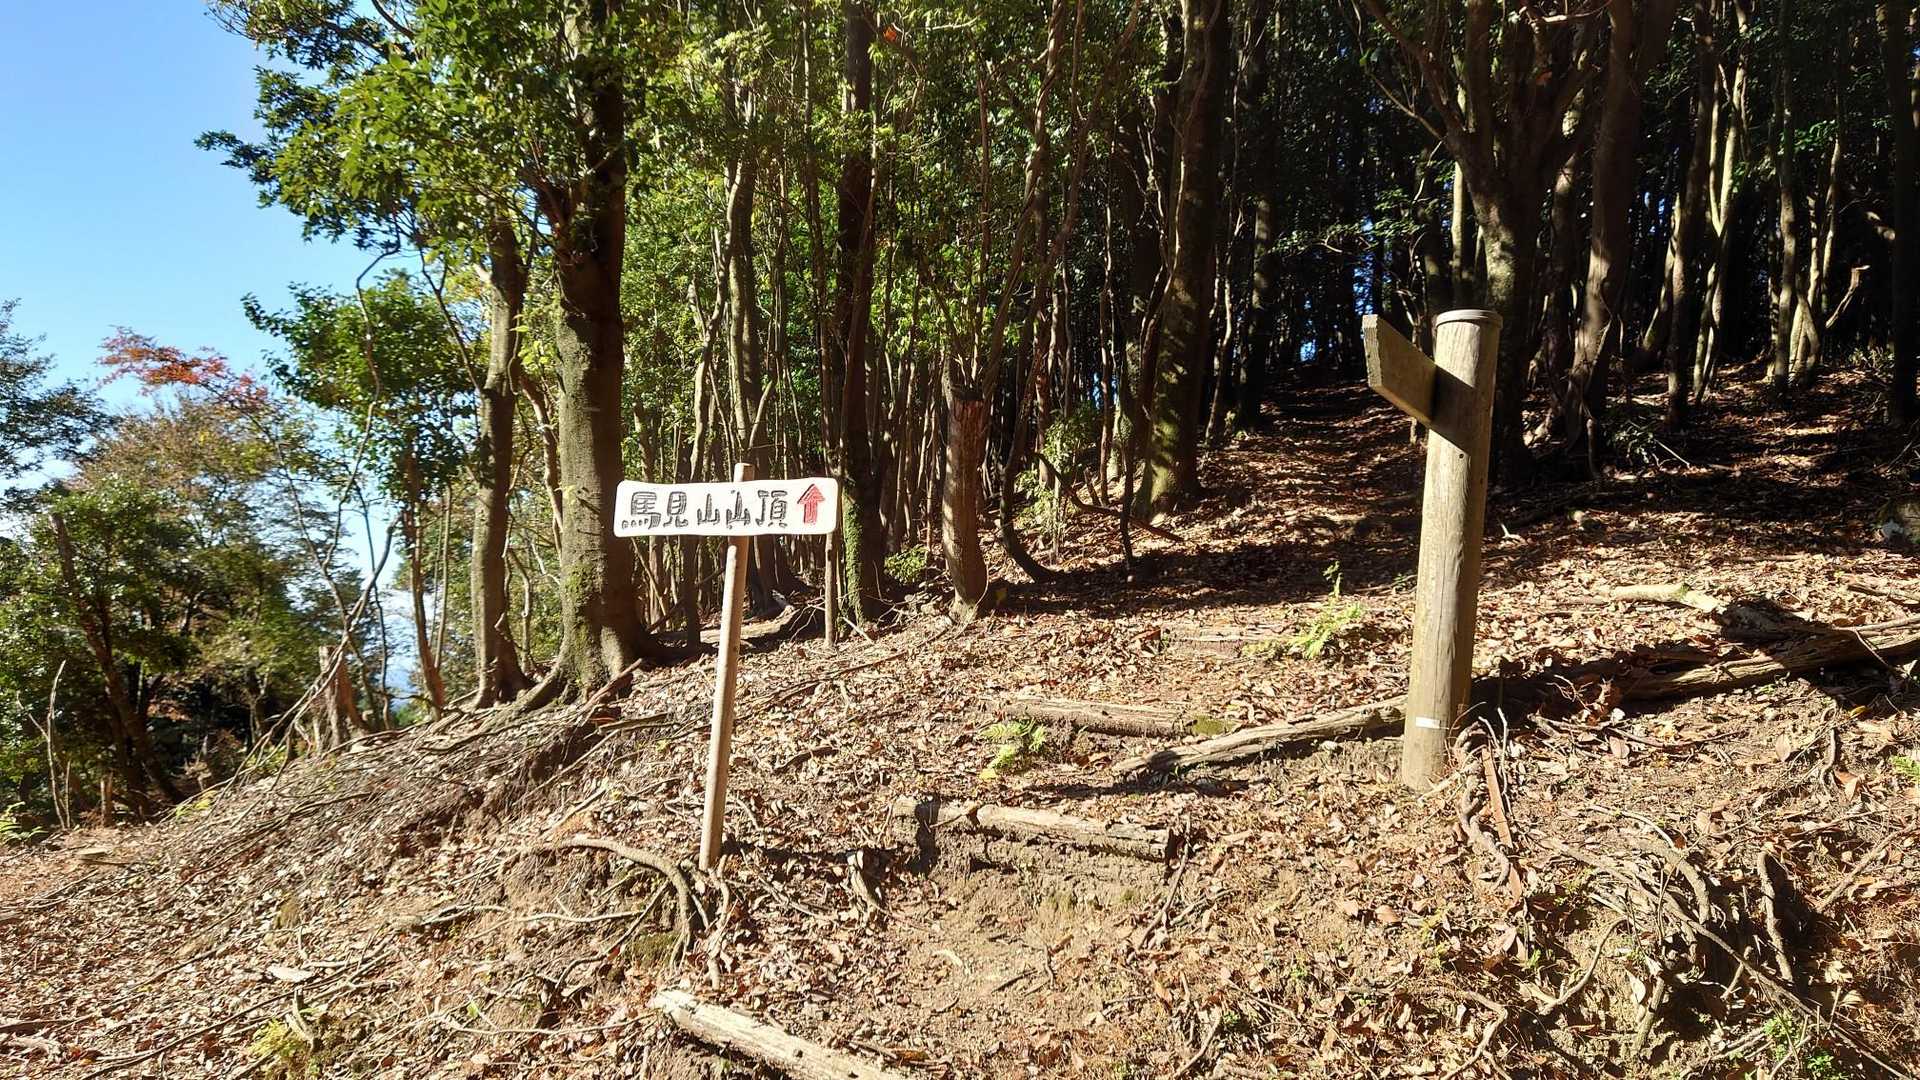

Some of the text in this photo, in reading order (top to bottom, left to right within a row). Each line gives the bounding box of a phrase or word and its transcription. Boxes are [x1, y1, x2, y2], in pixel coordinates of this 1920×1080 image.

[621, 489, 788, 529] 馬見山山頂
